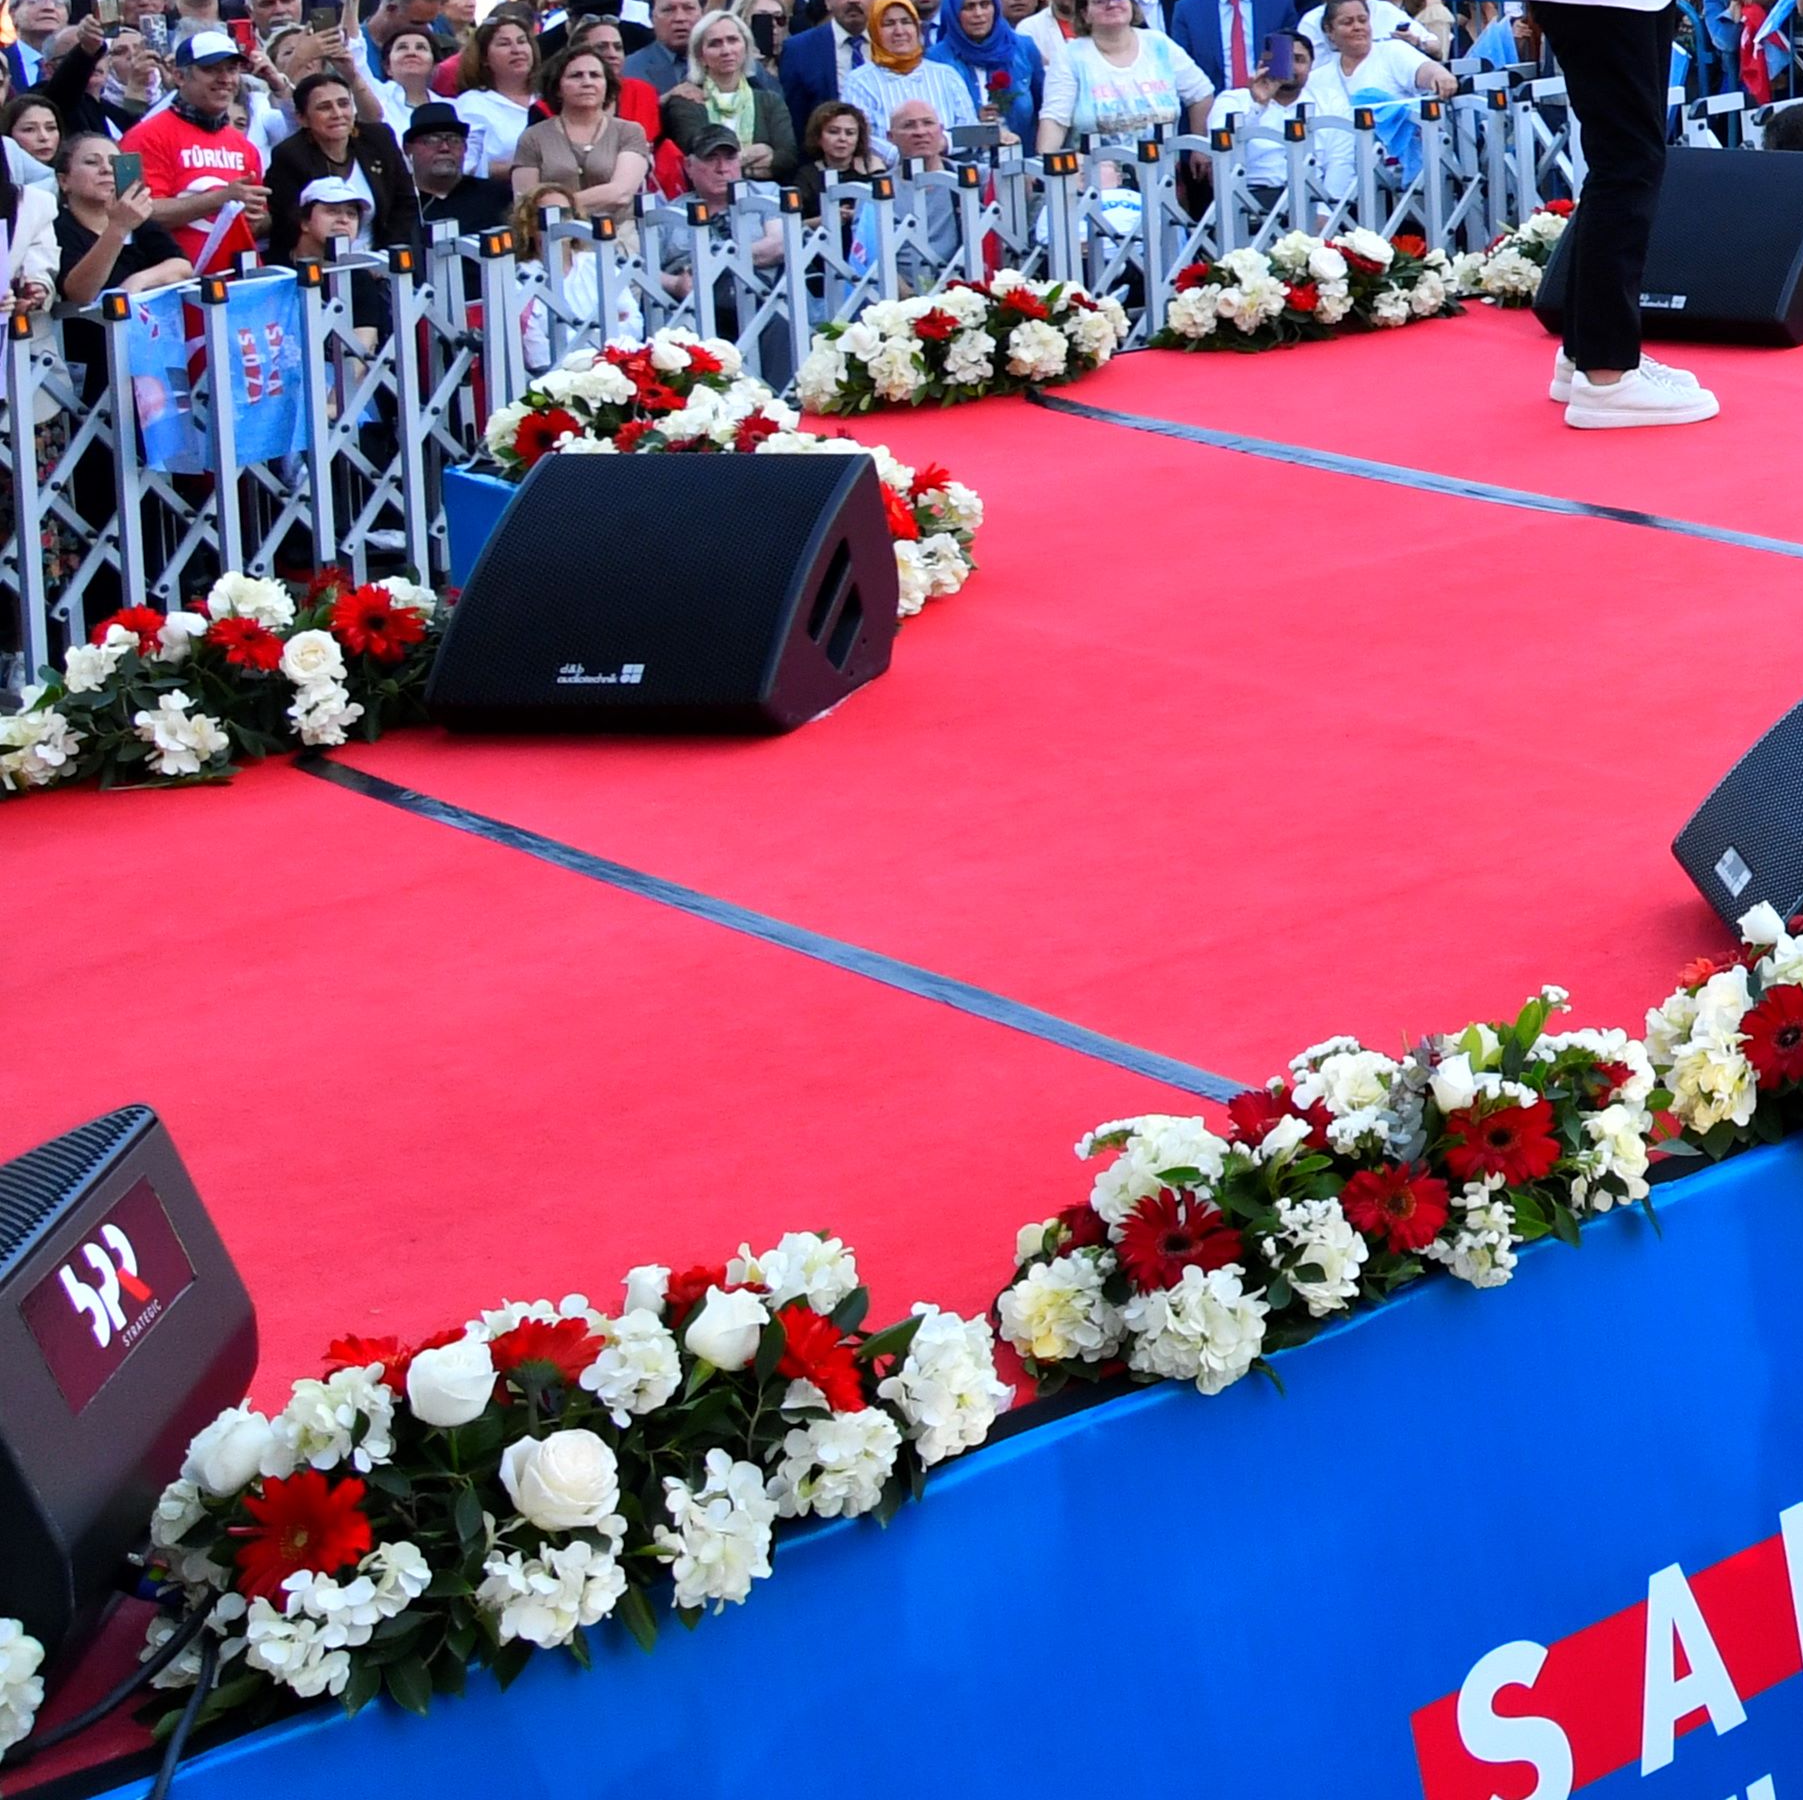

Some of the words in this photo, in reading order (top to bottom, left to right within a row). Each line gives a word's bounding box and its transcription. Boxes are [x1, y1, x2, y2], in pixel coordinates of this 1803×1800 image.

[181, 144, 245, 172] TÜRKİYE
[559, 663, 585, 674] d&b
[556, 673, 618, 684] audiotechnik
[121, 1298, 163, 1348] STRATEGIC
